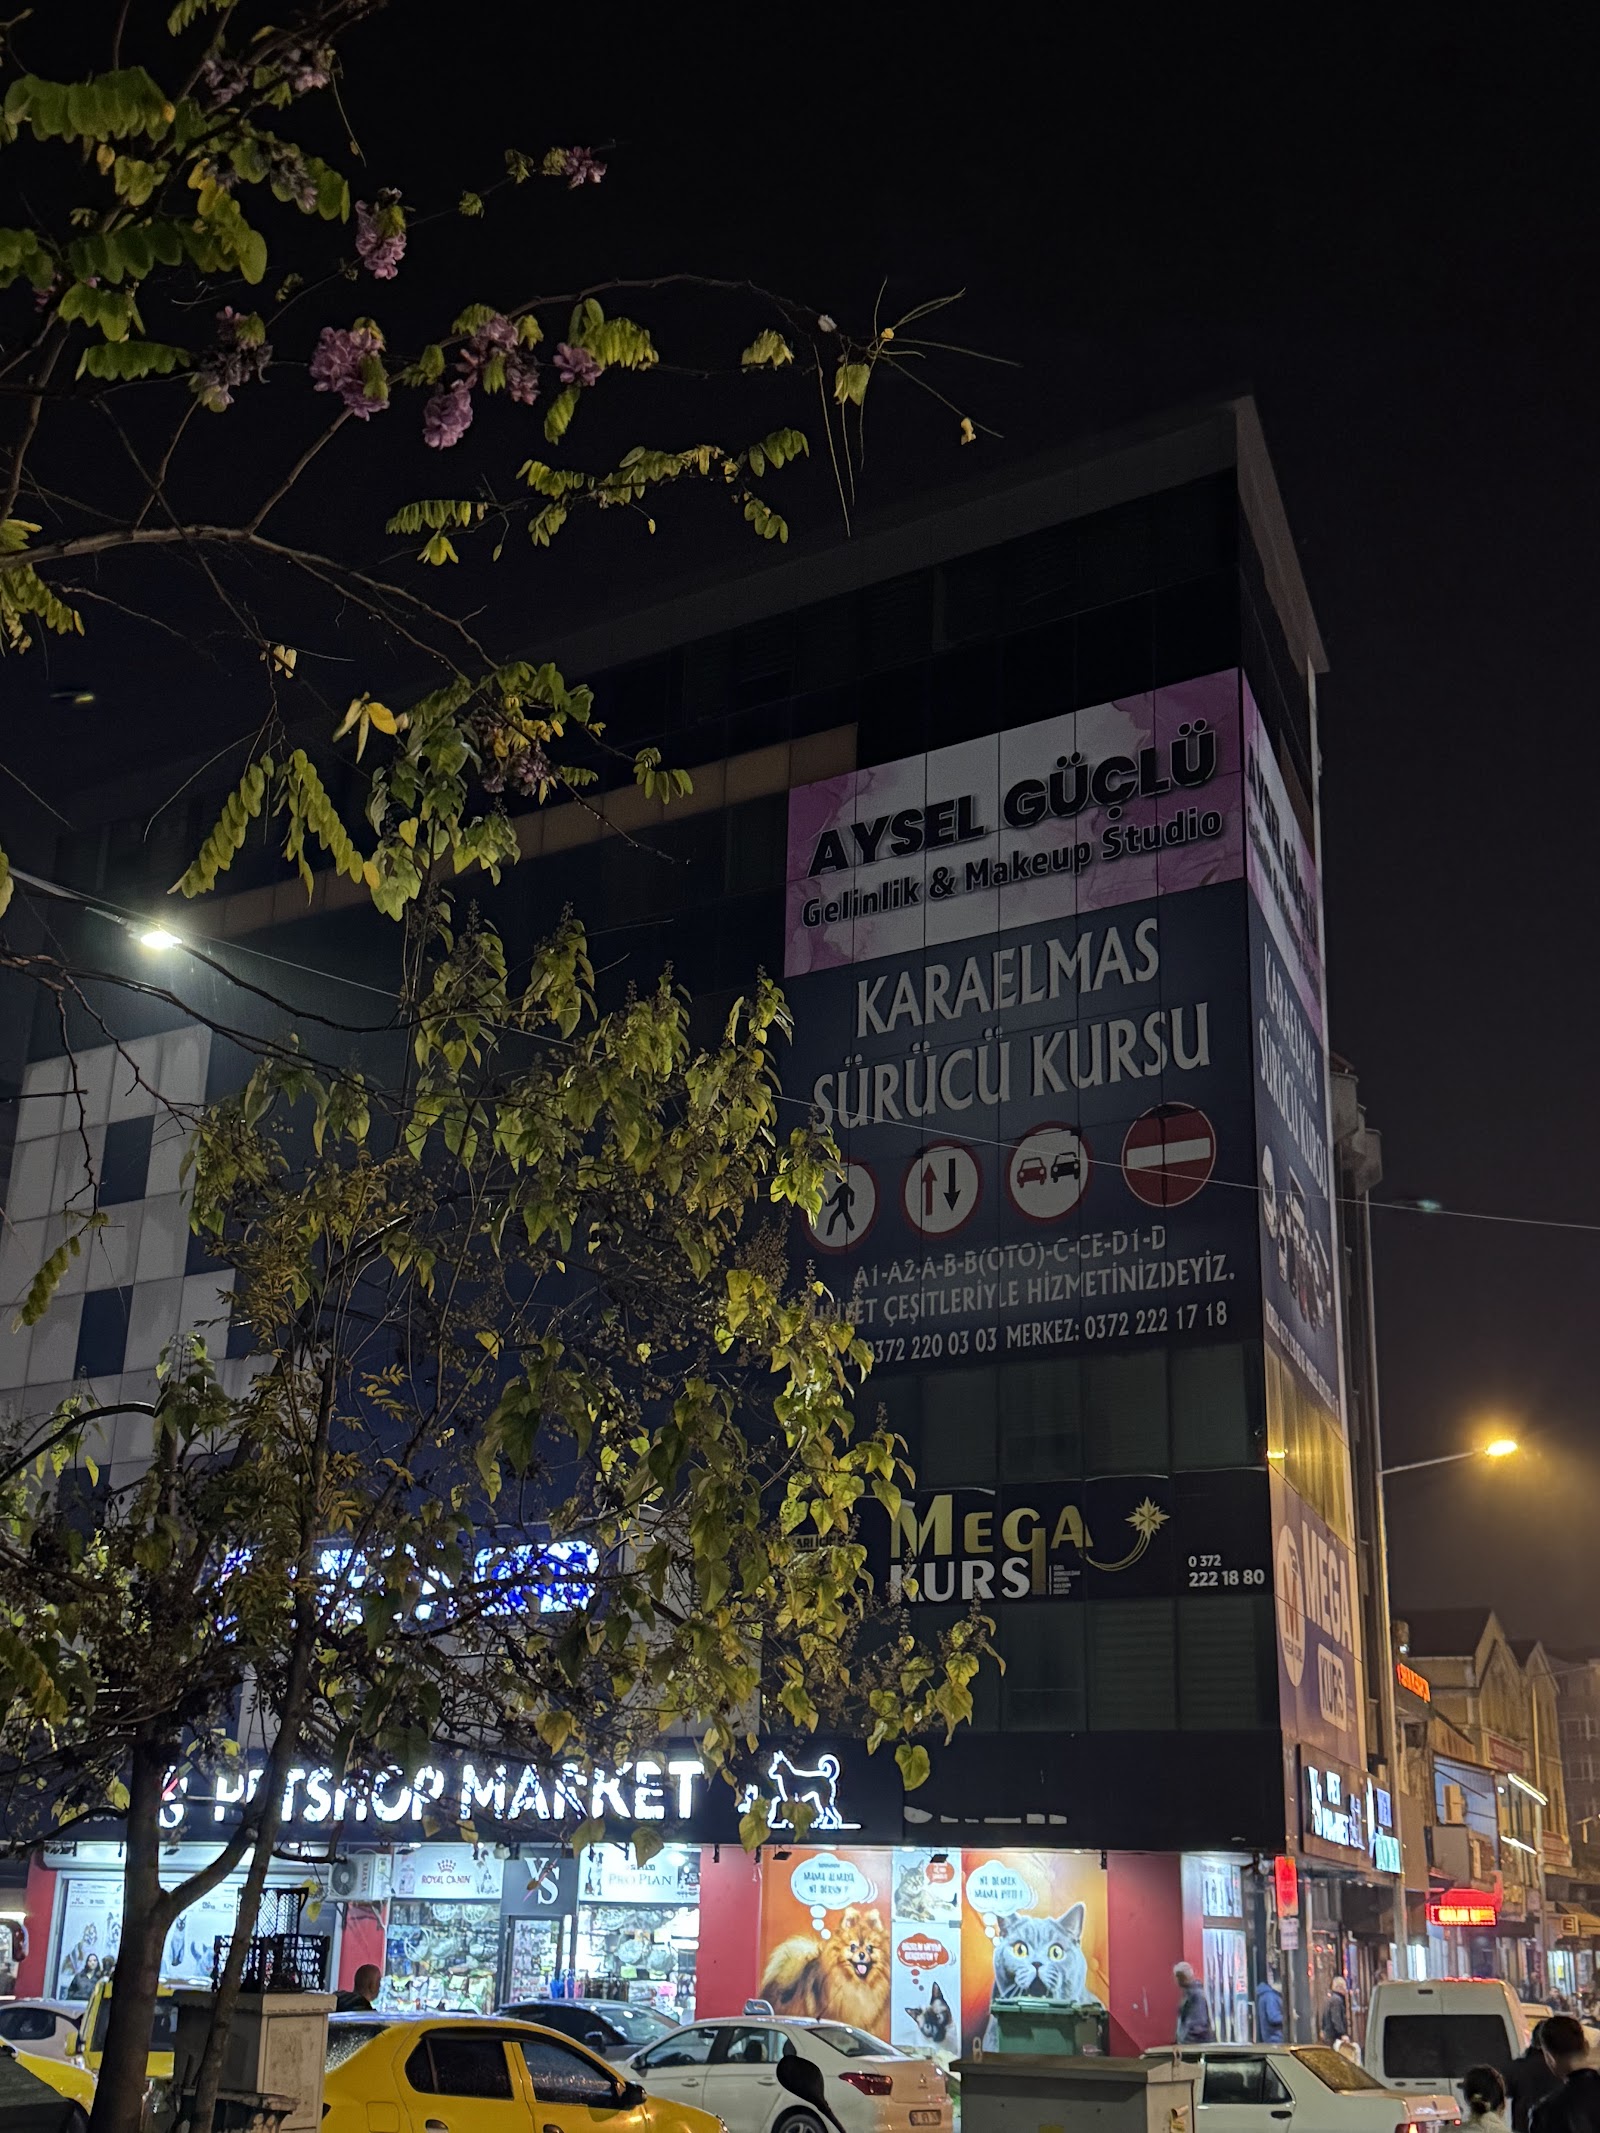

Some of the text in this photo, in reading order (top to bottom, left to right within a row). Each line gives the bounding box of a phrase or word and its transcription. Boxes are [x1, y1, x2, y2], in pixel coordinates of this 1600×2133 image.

[806, 719, 1216, 878] AYSEL GÜÇLÜ
[802, 806, 1223, 928] Gelinlik & Makeup Studio
[856, 917, 1160, 1038] KARAELMAS
[812, 1001, 1211, 1135] SÜRÜCÜ KURSU
[883, 1277, 1020, 1328] ÇEŞİTLERİYLE
[1027, 1250, 1236, 1305] HİZMETİNİZDEYİZ.
[911, 1333, 943, 1360] 220
[947, 1329, 970, 1356] 03
[975, 1326, 998, 1352] 03
[1006, 1318, 1081, 1349] MERKEZ:
[1084, 1311, 1130, 1341] 0372
[1135, 1307, 1169, 1336] 222
[1176, 1303, 1199, 1330] 17
[1205, 1300, 1228, 1327] 18
[889, 1557, 1031, 1602] KURS
[1187, 1554, 1222, 1568] 0 372
[1188, 1568, 1266, 1588] 222 18 80
[1302, 1520, 1353, 1654] MEGA
[459, 1760, 704, 1820] MARKET
[421, 1875, 444, 1885] ROYAL
